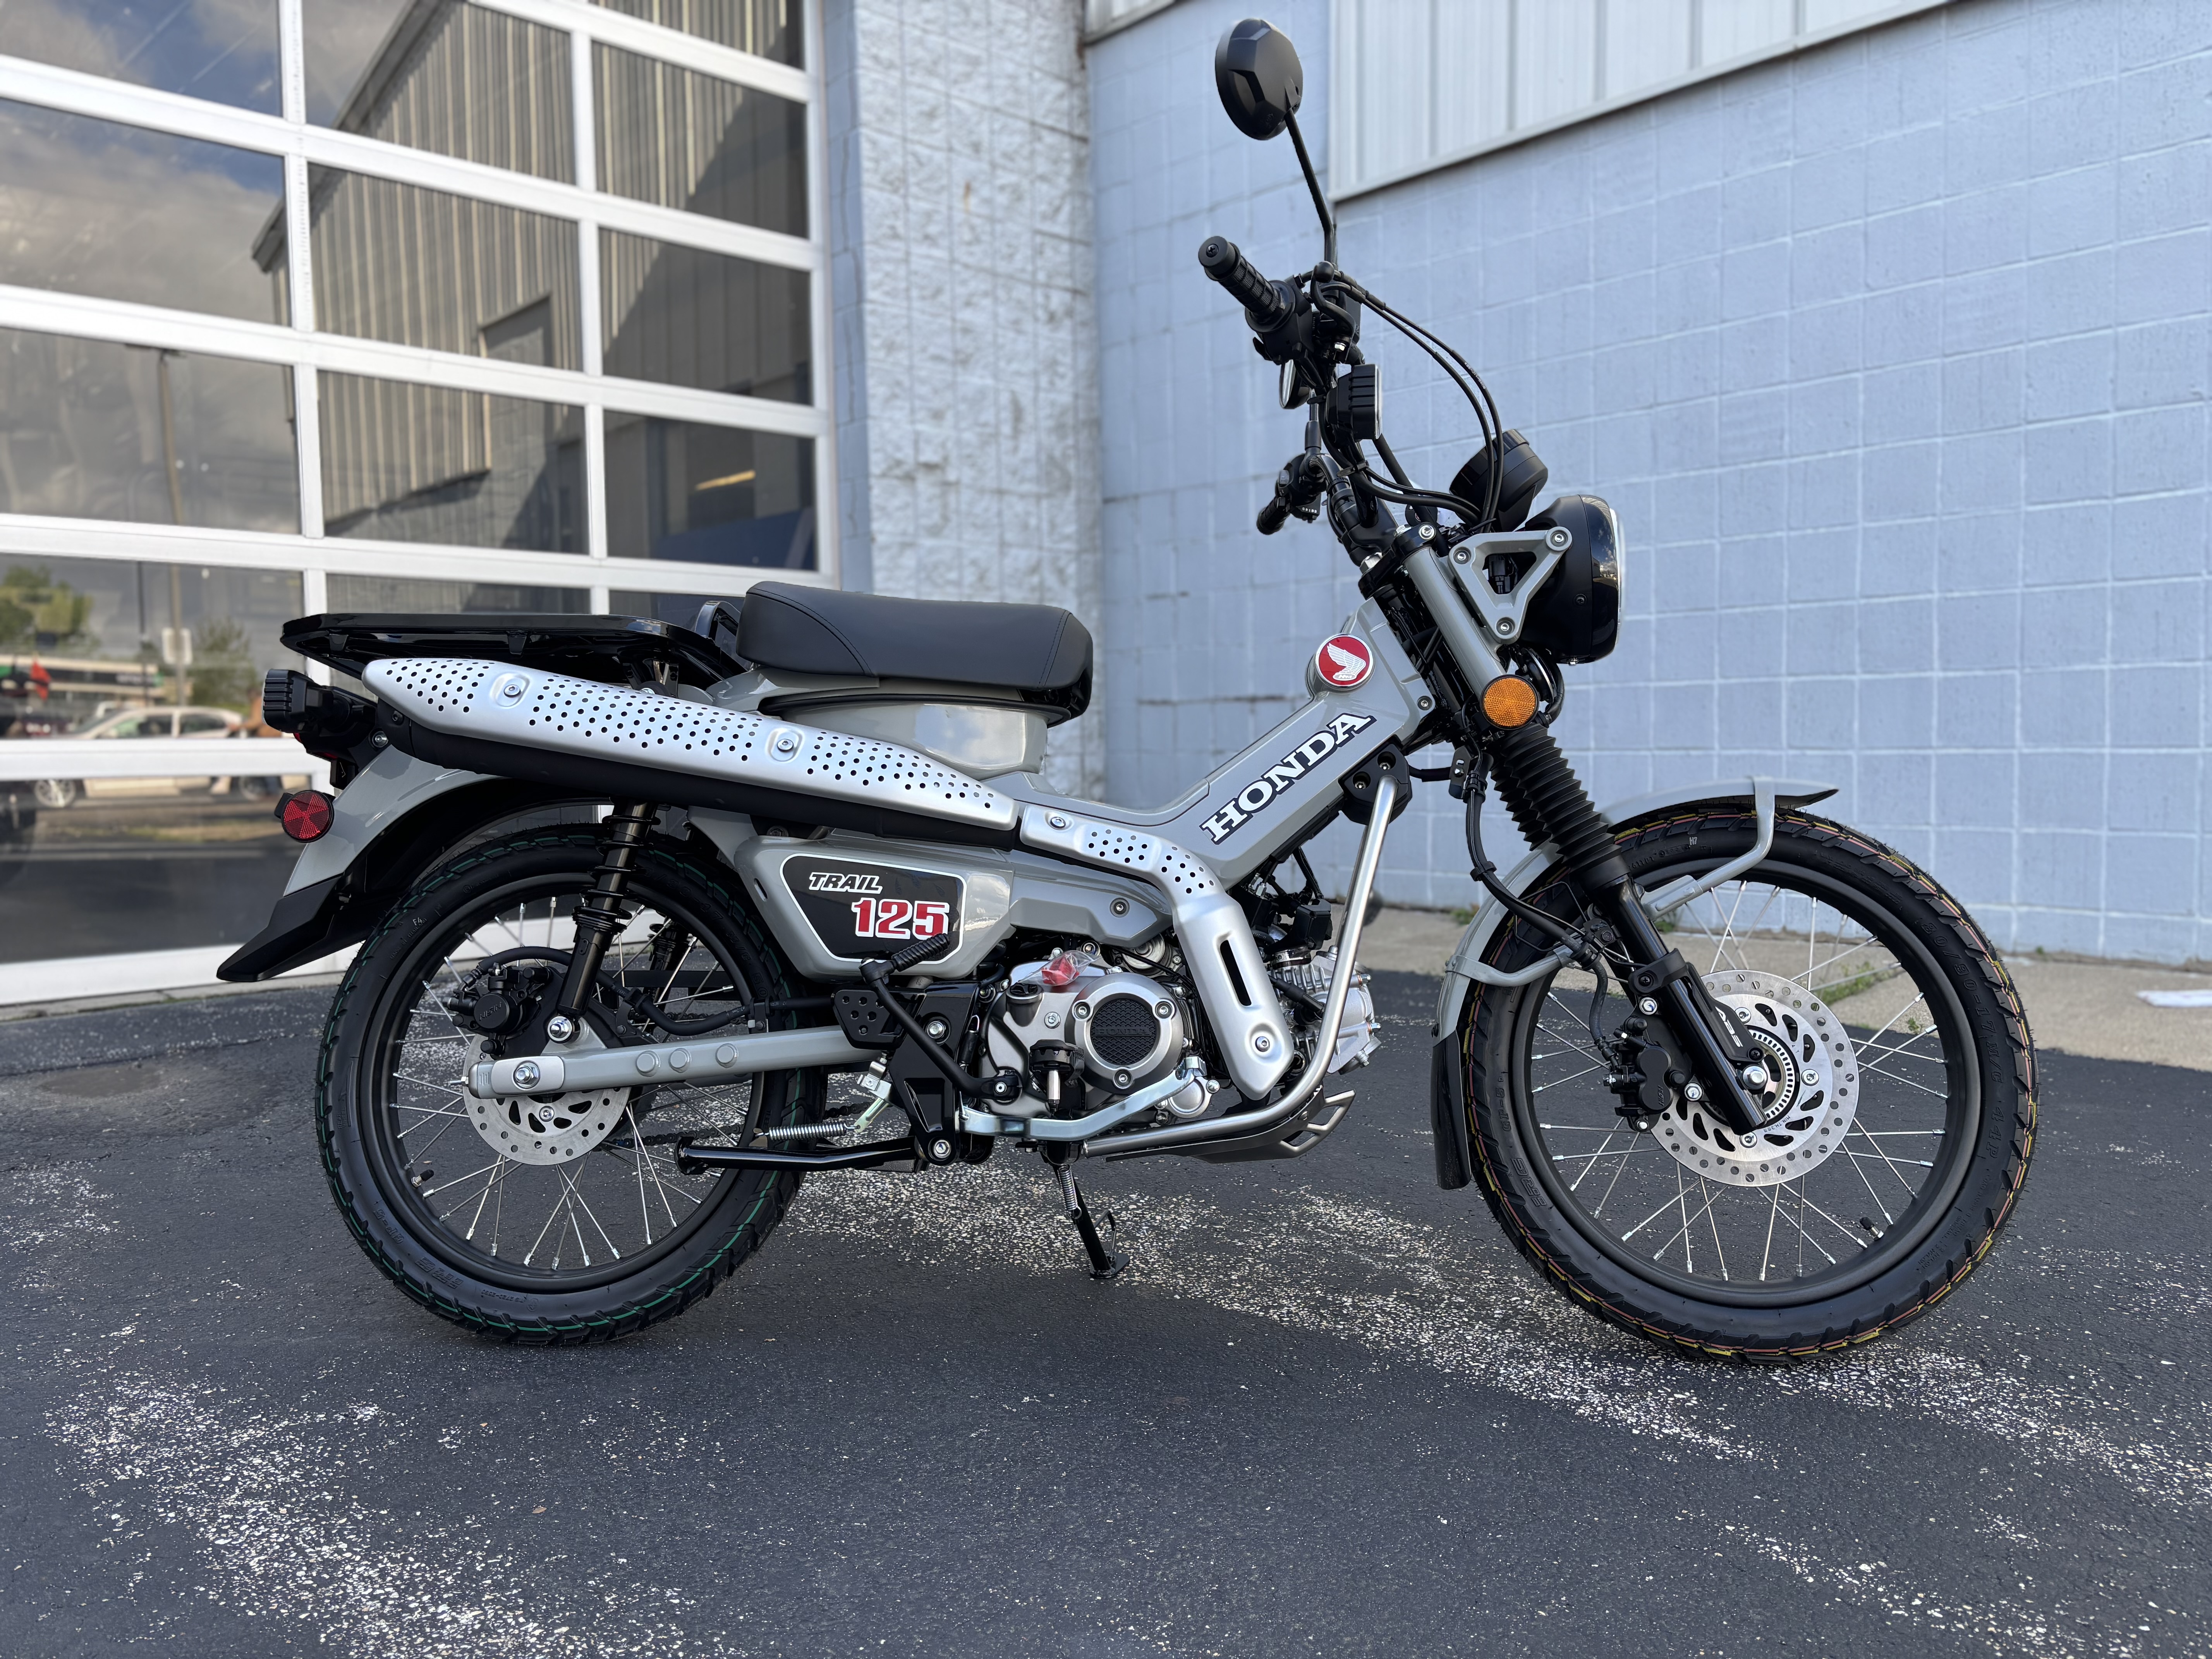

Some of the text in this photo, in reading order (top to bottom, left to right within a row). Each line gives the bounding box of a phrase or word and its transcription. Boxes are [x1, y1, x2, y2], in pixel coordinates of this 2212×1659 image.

[1200, 713, 1376, 845] HONDA
[809, 872, 883, 893] TRAIL
[852, 897, 950, 940] 125
[1096, 1027, 1151, 1036] HONDA
[1715, 1006, 1743, 1047] ABS
[1920, 920, 2005, 1159] 80/90-17 M/C 44P
[1496, 1088, 1511, 1132] GP-5
[374, 1209, 404, 1243] GP-5
